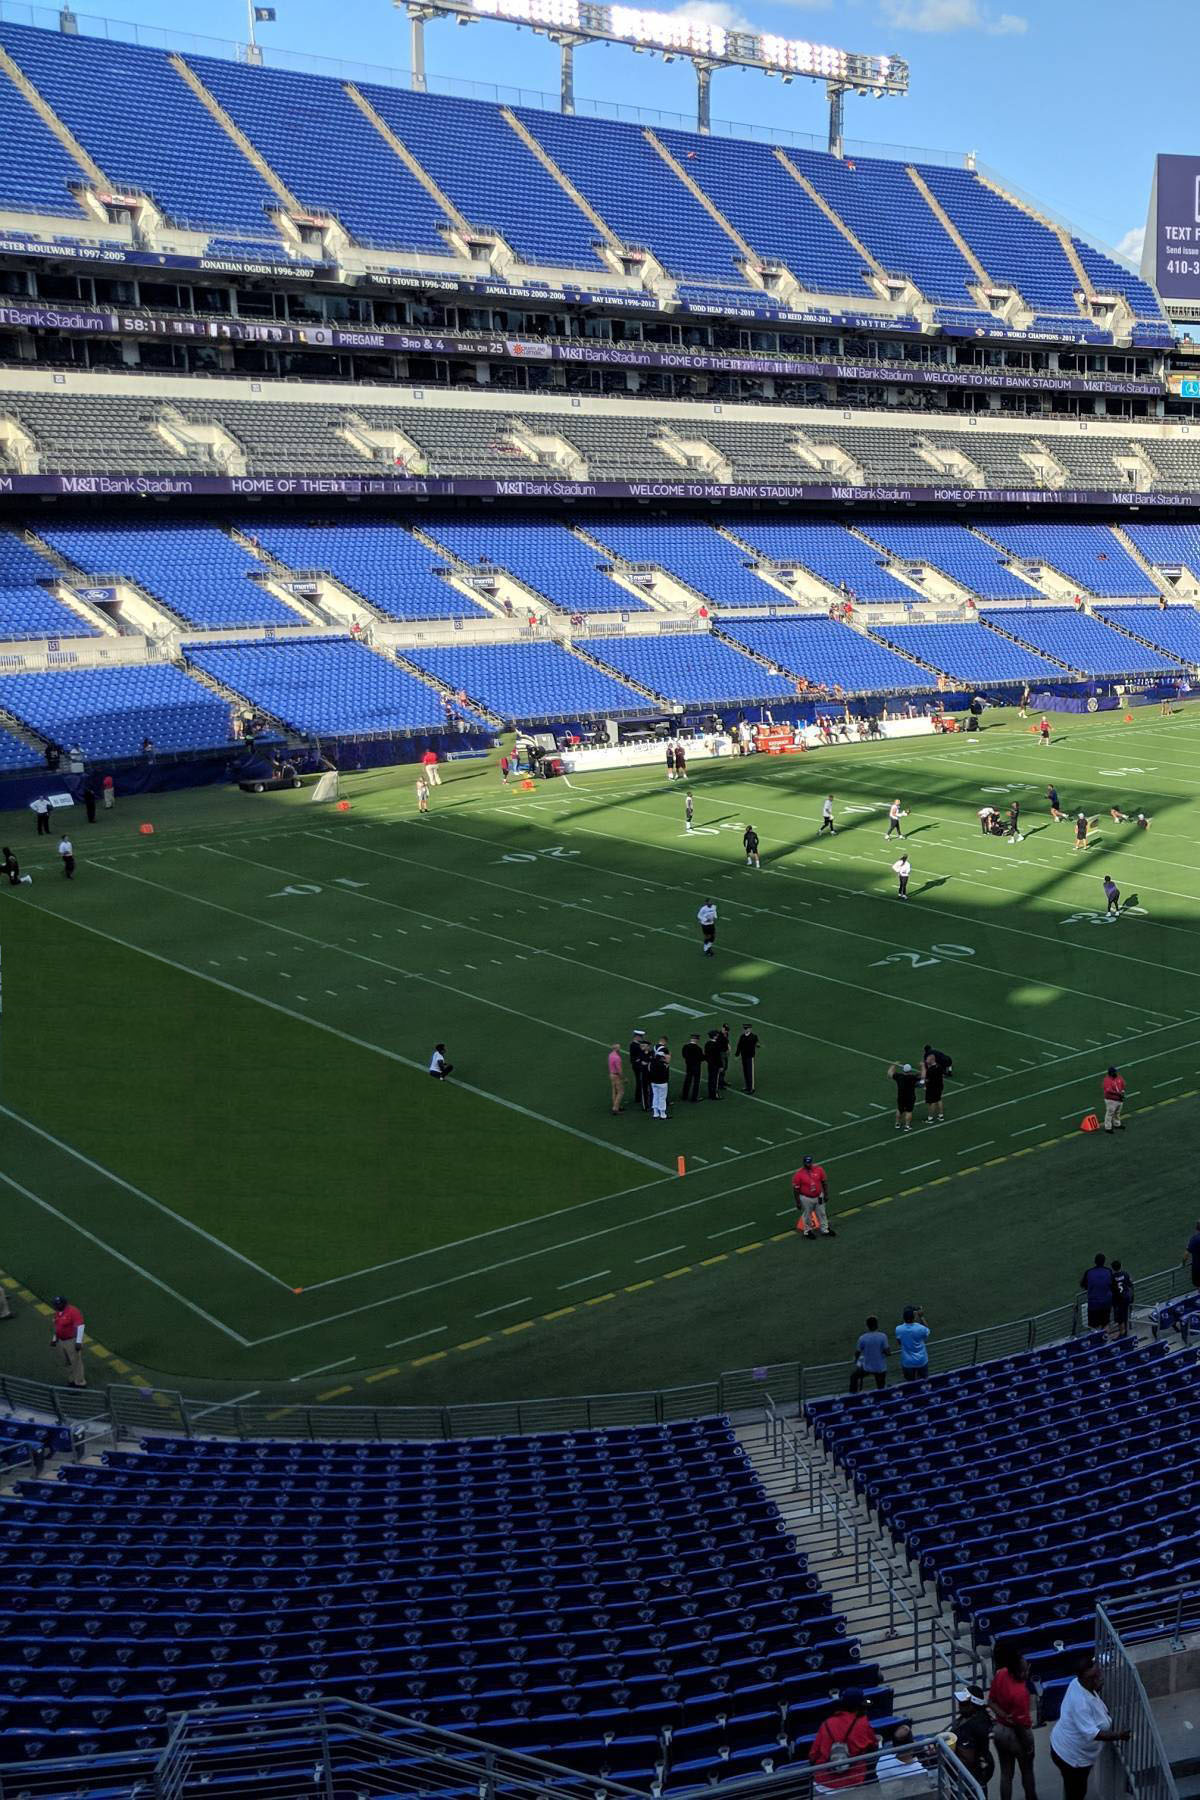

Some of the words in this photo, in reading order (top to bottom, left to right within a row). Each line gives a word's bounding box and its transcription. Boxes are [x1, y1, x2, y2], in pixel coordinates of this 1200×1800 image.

[1165, 226, 1192, 241] TEXT
[28, 244, 76, 256] BOULWARE
[79, 249, 126, 261] 1997-2005
[1166, 246, 1181, 255] Send
[1182, 247, 1199, 255] issue
[200, 260, 242, 272] JONATHAN
[244, 264, 272, 274] OGDEN
[274, 267, 314, 278] 1996-2007
[372, 275, 391, 285] MATT
[393, 277, 420, 287] STOVER
[485, 286, 508, 295] JAMAL
[509, 288, 530, 297] LEWIS
[531, 290, 566, 300] 2000-2006
[605, 297, 624, 305] LEWIS
[624, 299, 656, 308] 1996-2012
[689, 304, 706, 312] TODD
[707, 305, 723, 314] HEAP
[10, 309, 45, 326] Bank
[47, 312, 103, 330] Stadium
[124, 318, 166, 332] 58:11
[1007, 331, 1027, 339] WORLD
[1028, 332, 1059, 340] CHAMPIONS
[339, 333, 385, 347] PREGAME
[436, 339, 445, 350] 4
[457, 344, 475, 352] BALL
[490, 343, 503, 354] 25
[559, 347, 586, 360] M&T
[586, 350, 610, 361] Bank
[610, 351, 650, 364] Stadium
[661, 355, 692, 368] HOME
[693, 357, 708, 368] OF
[837, 366, 859, 377] M&T
[859, 367, 879, 379] Bank
[880, 368, 914, 381] Stadium
[924, 372, 968, 384] WELCOME
[970, 375, 982, 384] TO
[984, 376, 1004, 386] M&T
[1005, 377, 1031, 388] BANK
[1032, 378, 1072, 389] STADIUM
[1083, 381, 1105, 392] M&T
[1105, 382, 1126, 392] Bank
[1127, 382, 1160, 394] Stadium
[61, 476, 99, 492] M&T
[100, 477, 135, 492] Bank
[136, 477, 192, 493] Stadium
[232, 479, 274, 492] HOME
[278, 479, 296, 492] OF
[496, 481, 525, 494] M&T
[525, 482, 552, 495] Bank
[553, 482, 595, 495] Stadium
[629, 484, 685, 496] WELCOME
[687, 485, 702, 496] TO
[705, 485, 727, 496] M&T
[730, 486, 757, 497] BANK
[760, 487, 803, 497] STADIUM
[831, 487, 854, 499] M&T
[855, 488, 876, 499] Bank
[877, 488, 910, 500] Stadium
[934, 490, 961, 500] HOME
[963, 490, 976, 500] OF
[1112, 493, 1134, 504] M&T
[1135, 493, 1157, 504] Bank
[1157, 494, 1191, 505] Stadium
